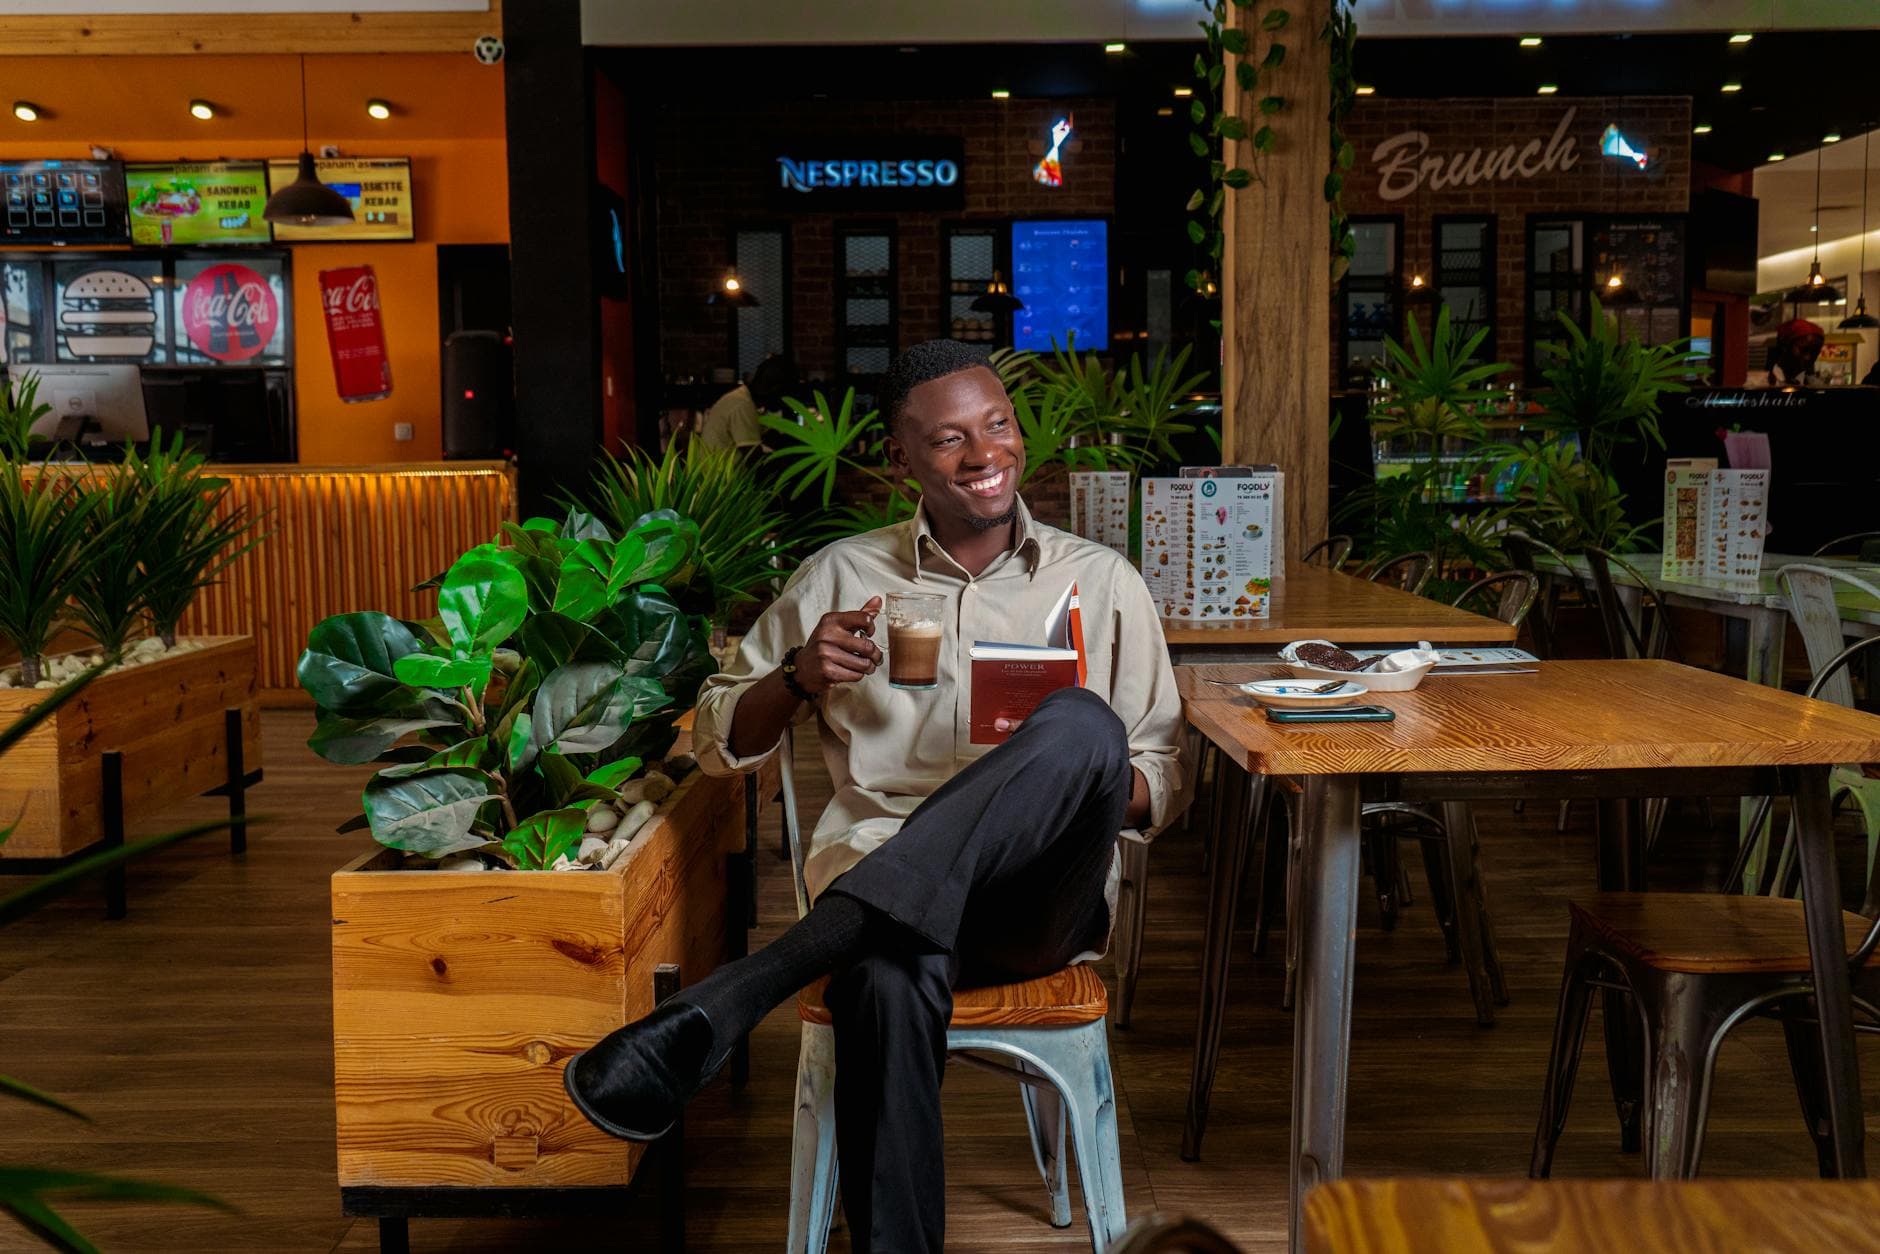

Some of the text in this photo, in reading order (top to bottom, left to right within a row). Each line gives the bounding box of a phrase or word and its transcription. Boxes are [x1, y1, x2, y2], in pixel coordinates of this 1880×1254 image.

[1371, 106, 1580, 200] Brunch
[207, 185, 257, 196] SANDWICH
[218, 200, 251, 209] KEBAB
[364, 197, 398, 206] KEBAB
[193, 283, 270, 328] Coca-Cola
[1688, 472, 1709, 480] FOODLY
[1740, 472, 1765, 480] FOODLY
[1170, 481, 1193, 491] FOODLY
[1237, 482, 1270, 491] FOODLY
